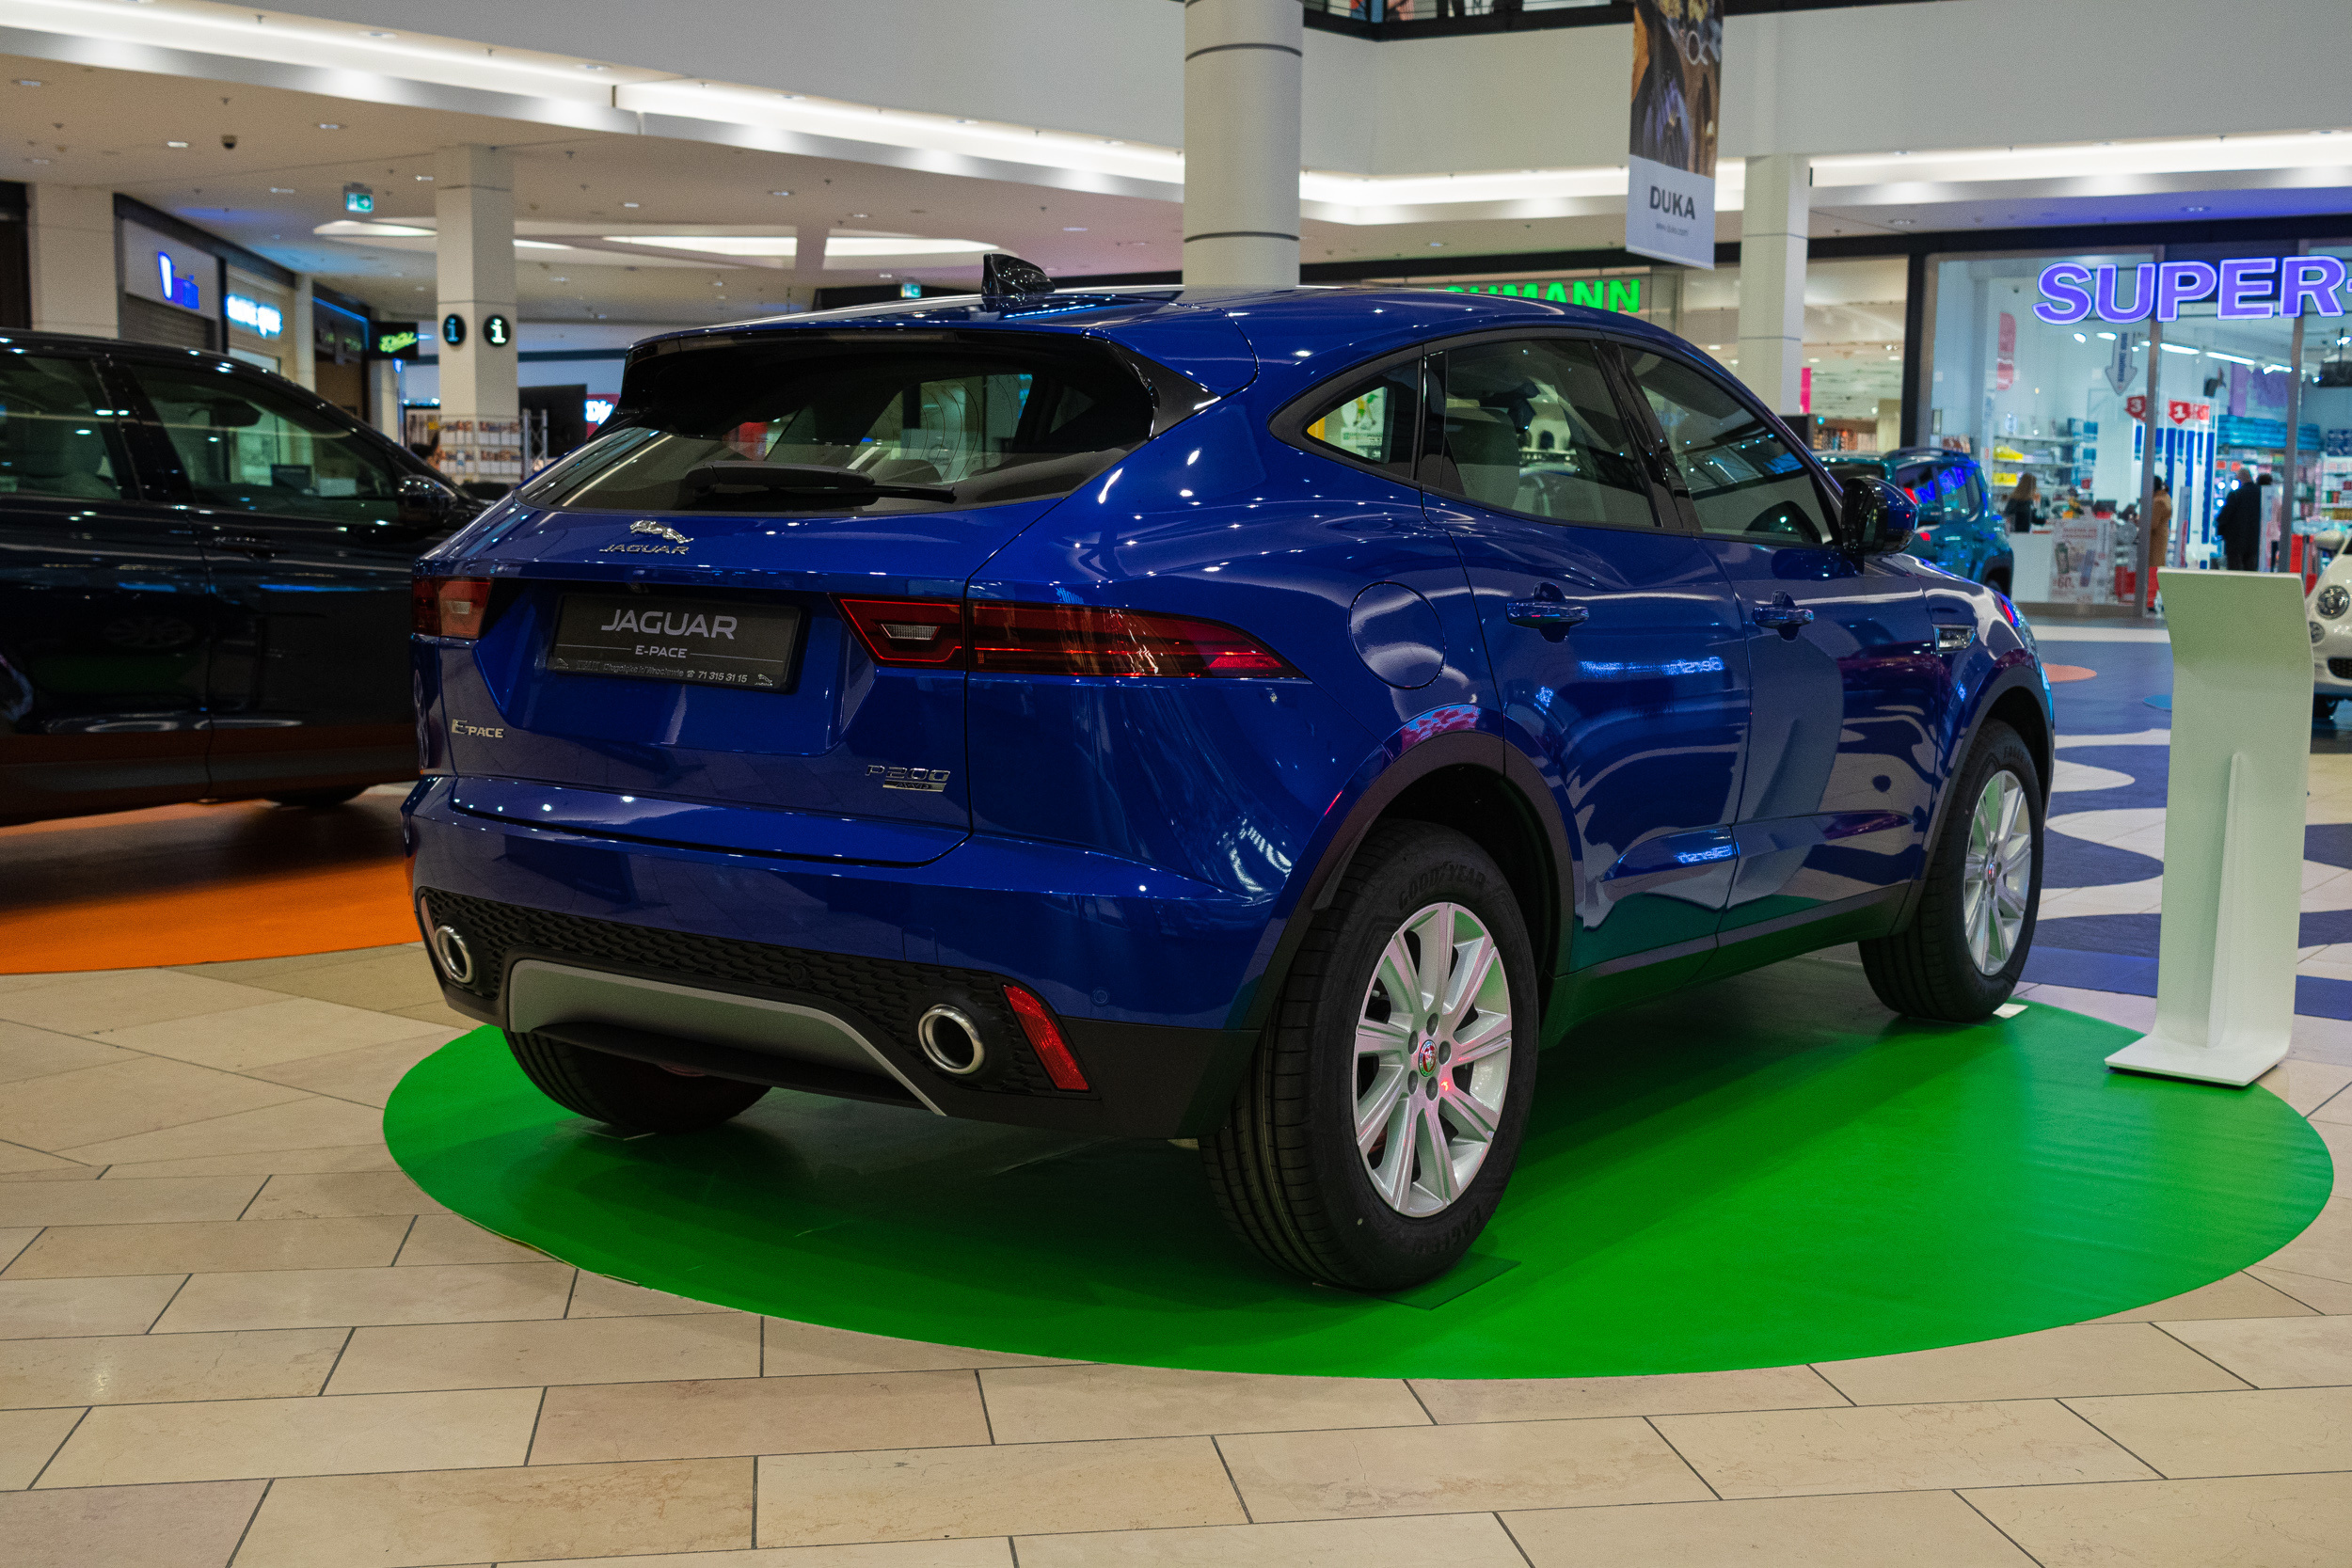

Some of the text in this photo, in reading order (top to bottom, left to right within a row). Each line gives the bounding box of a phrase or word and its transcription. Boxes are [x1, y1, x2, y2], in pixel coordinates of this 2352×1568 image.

[1649, 185, 1695, 220] DUKA
[599, 544, 690, 555] JAGUAR
[601, 609, 738, 640] JAGUAR
[635, 644, 688, 658] E-PACE
[698, 671, 707, 679] 71
[708, 671, 724, 681] 315
[725, 673, 736, 682] 31
[738, 673, 748, 683] 15
[864, 765, 950, 782] P200
[895, 781, 931, 790] AWD
